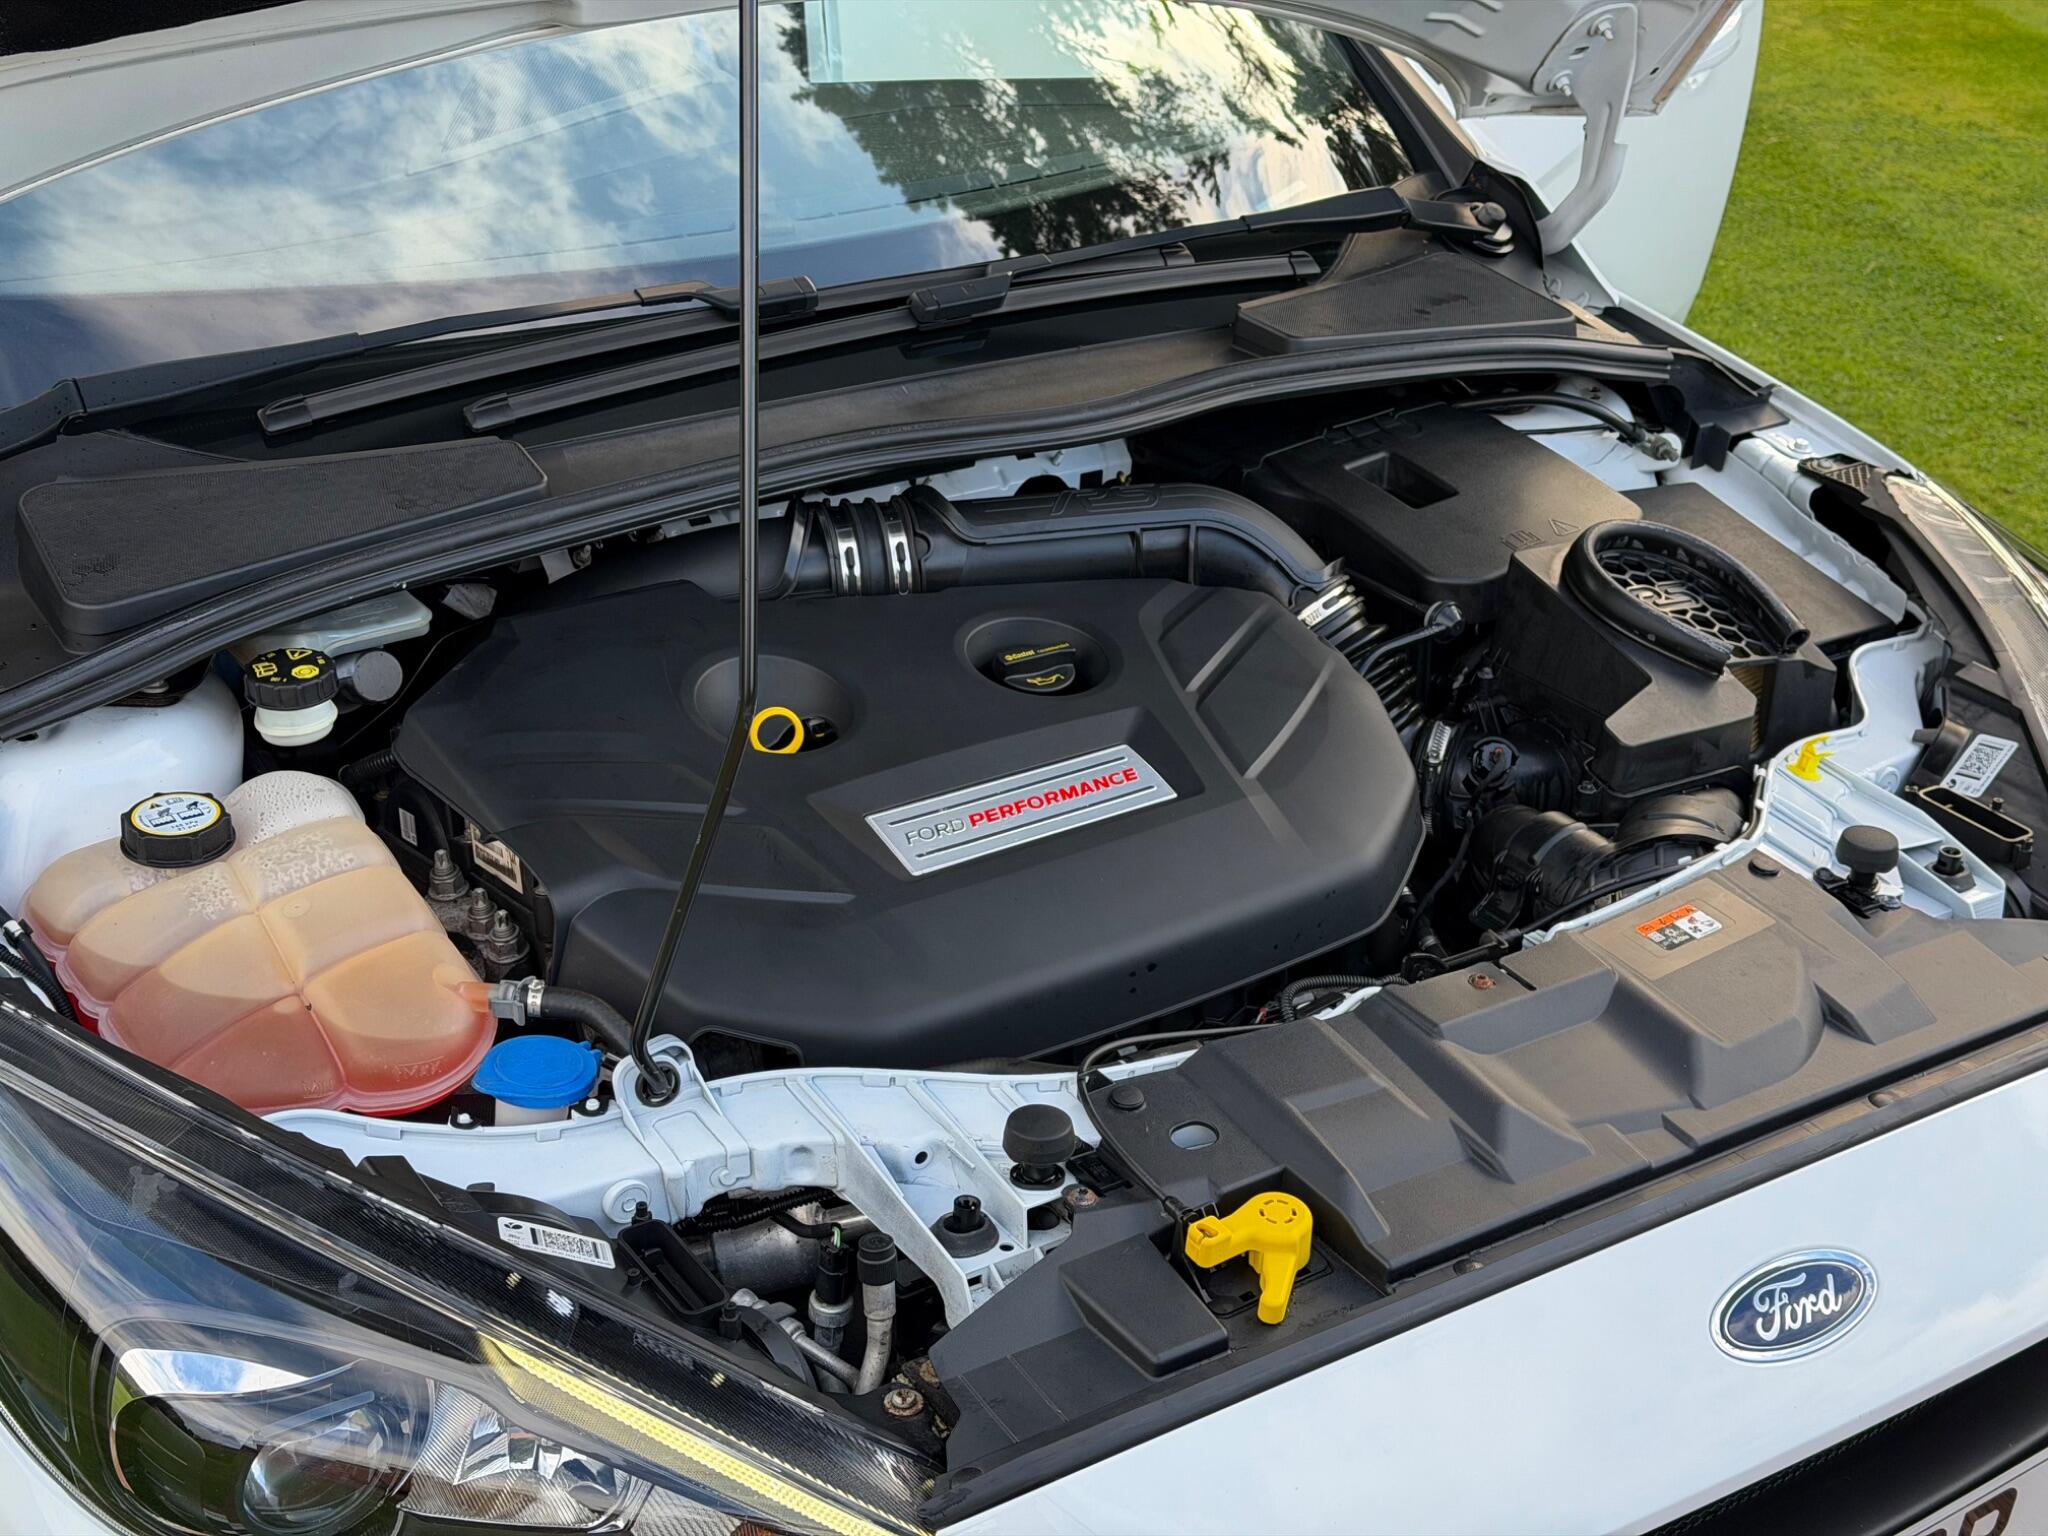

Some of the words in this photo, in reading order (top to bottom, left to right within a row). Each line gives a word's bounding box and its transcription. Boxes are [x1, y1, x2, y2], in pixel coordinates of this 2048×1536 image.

[904, 818, 967, 846] FORD
[967, 767, 1139, 828] PERFORMANCE
[1752, 1271, 1843, 1342] Ford
